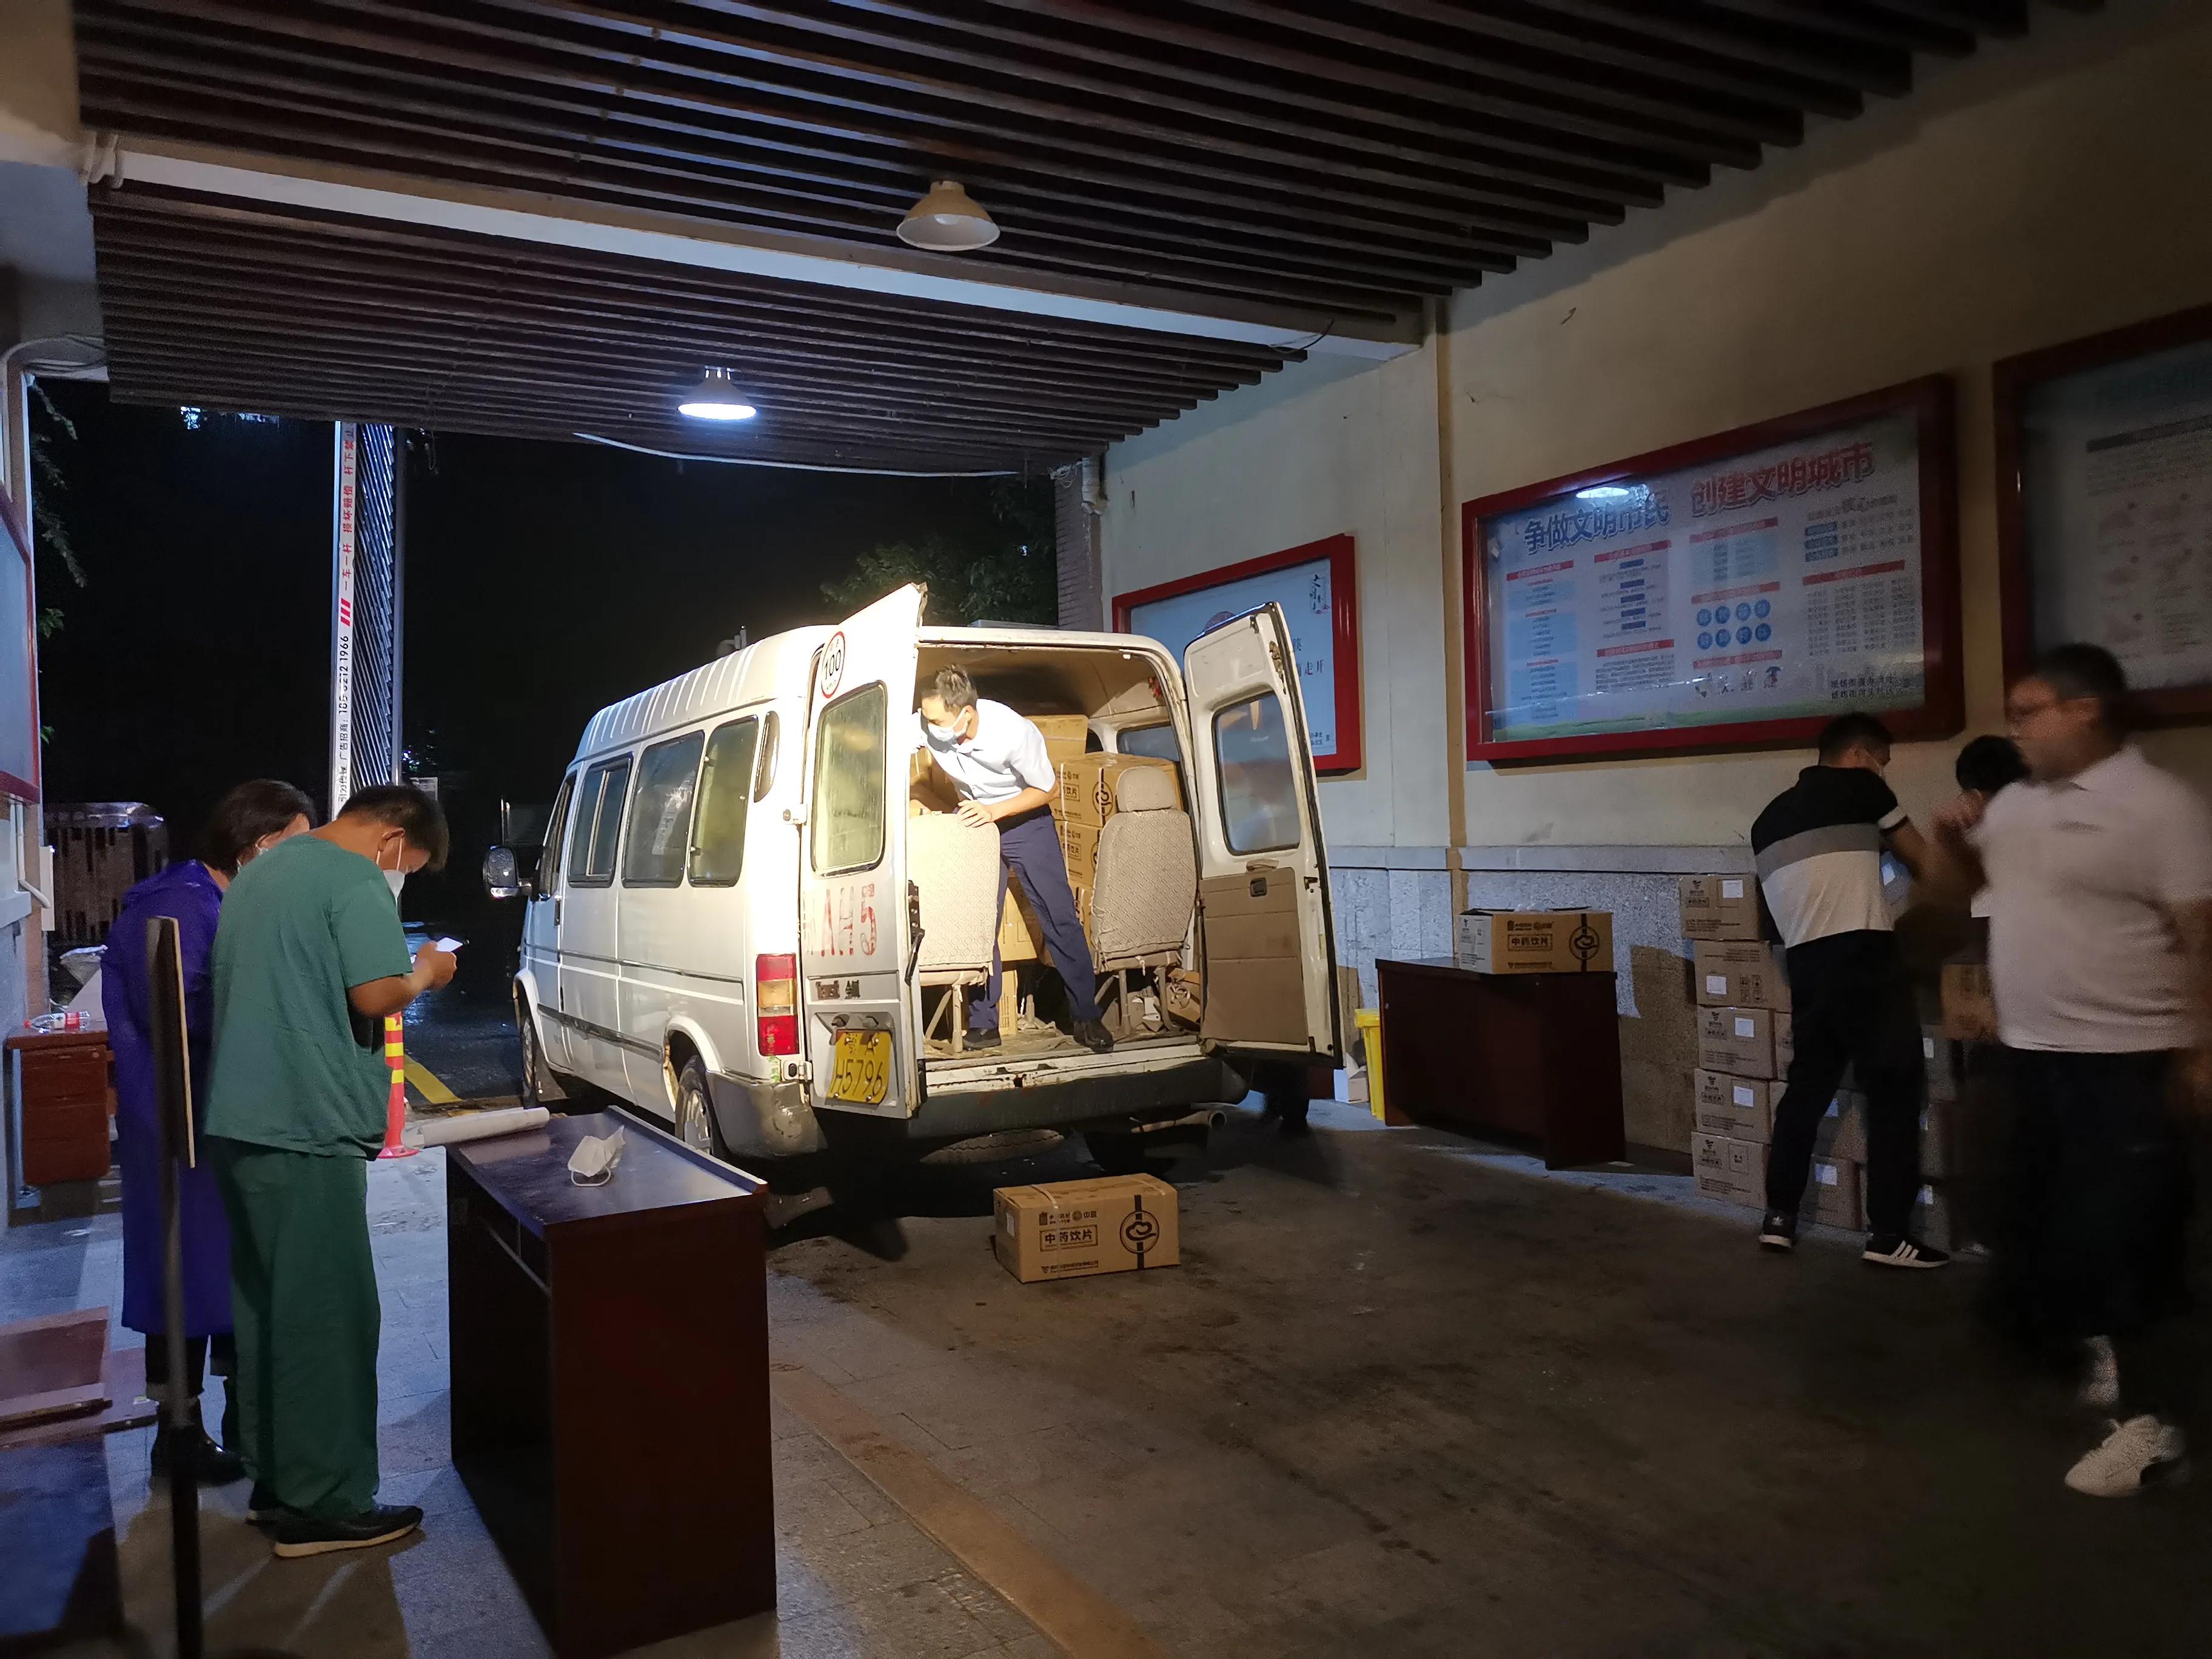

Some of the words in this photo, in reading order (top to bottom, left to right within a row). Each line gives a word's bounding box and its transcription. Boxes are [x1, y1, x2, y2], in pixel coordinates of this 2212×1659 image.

[343, 484, 354, 533] 损坏赔偿
[1524, 488, 1671, 554] 争做文明市民
[1691, 443, 1874, 515] 创建文明城市
[342, 543, 353, 591] 一车一杆
[340, 635, 349, 660] 1966
[825, 649, 841, 680] 100
[830, 1058, 883, 1097] H5796
[1045, 1229, 1093, 1244] 中药饮片
